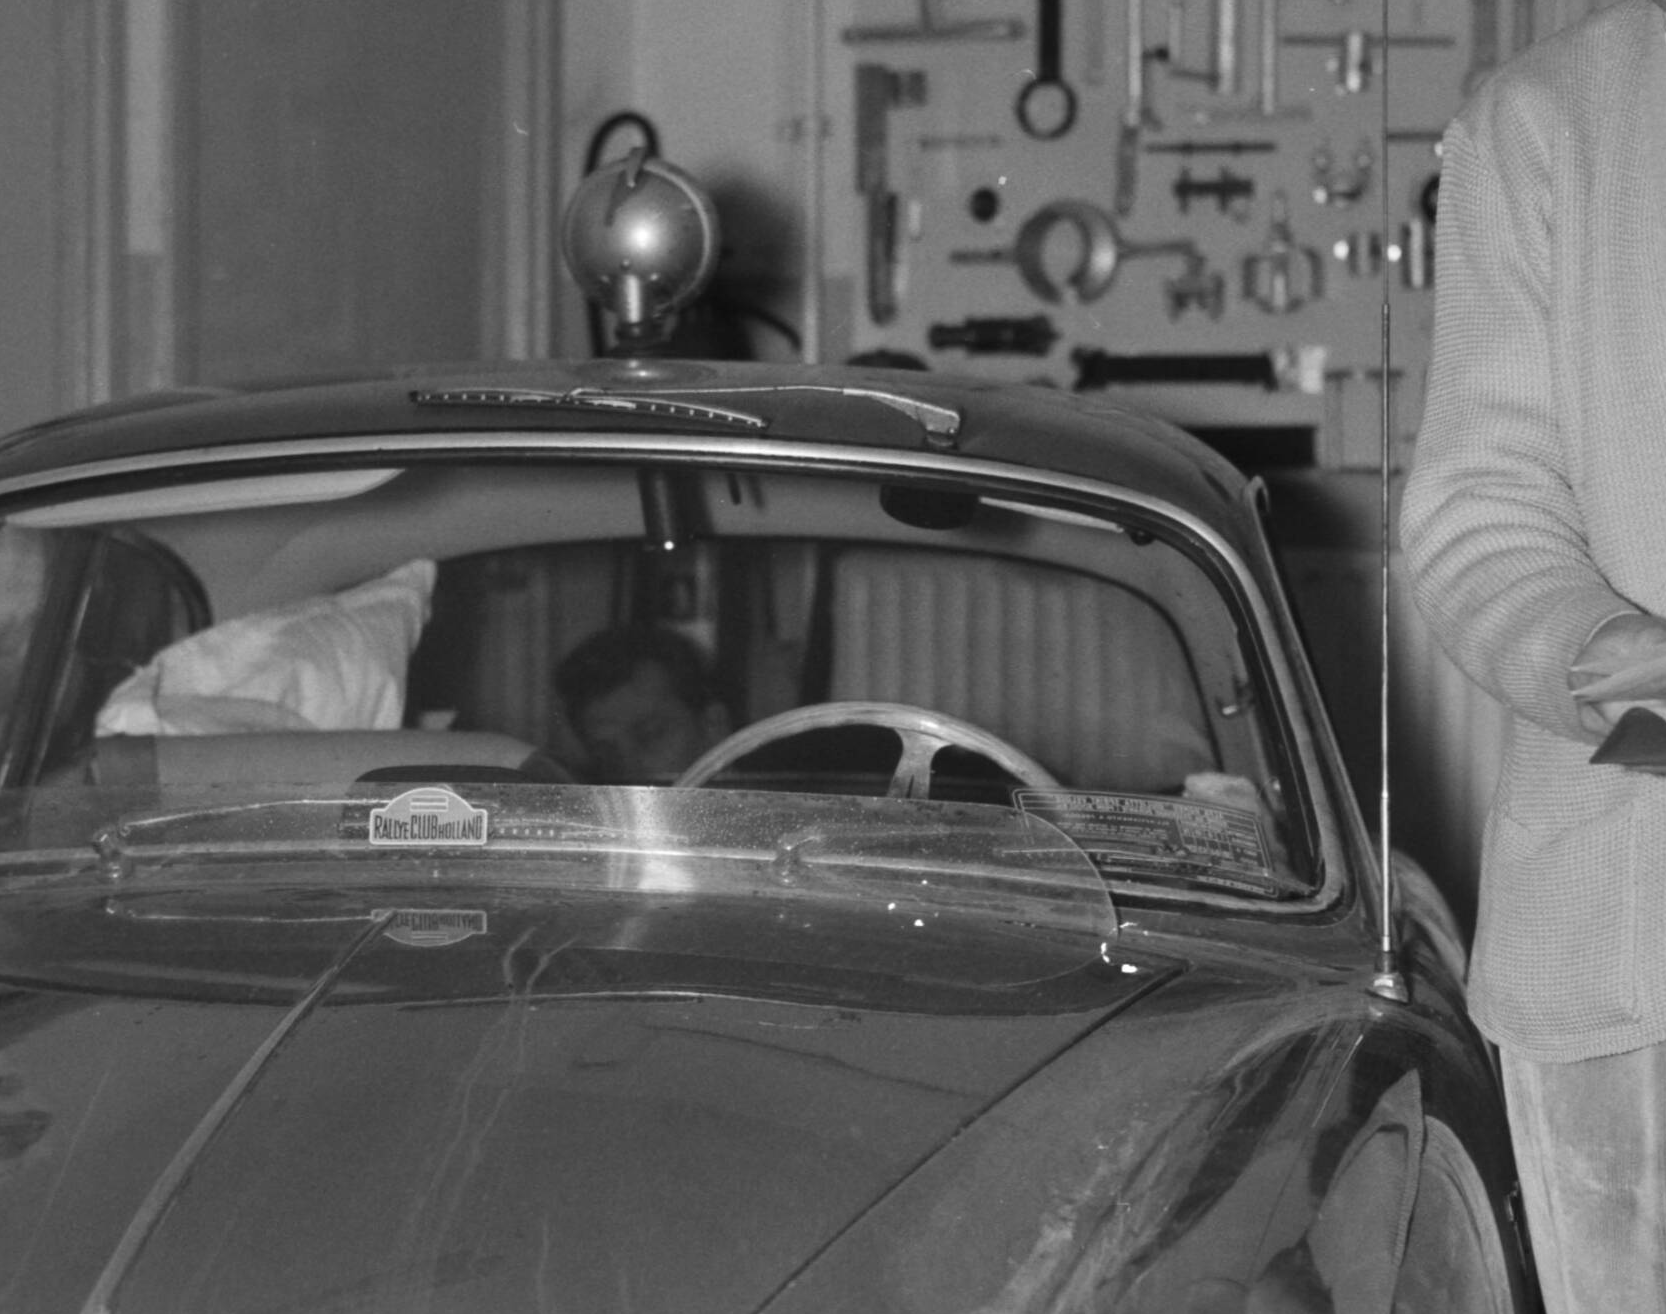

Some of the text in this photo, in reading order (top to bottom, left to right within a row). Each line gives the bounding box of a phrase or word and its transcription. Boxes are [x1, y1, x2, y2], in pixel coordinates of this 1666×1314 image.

[375, 813, 482, 839] RALLYE CLUB HOLLAND
